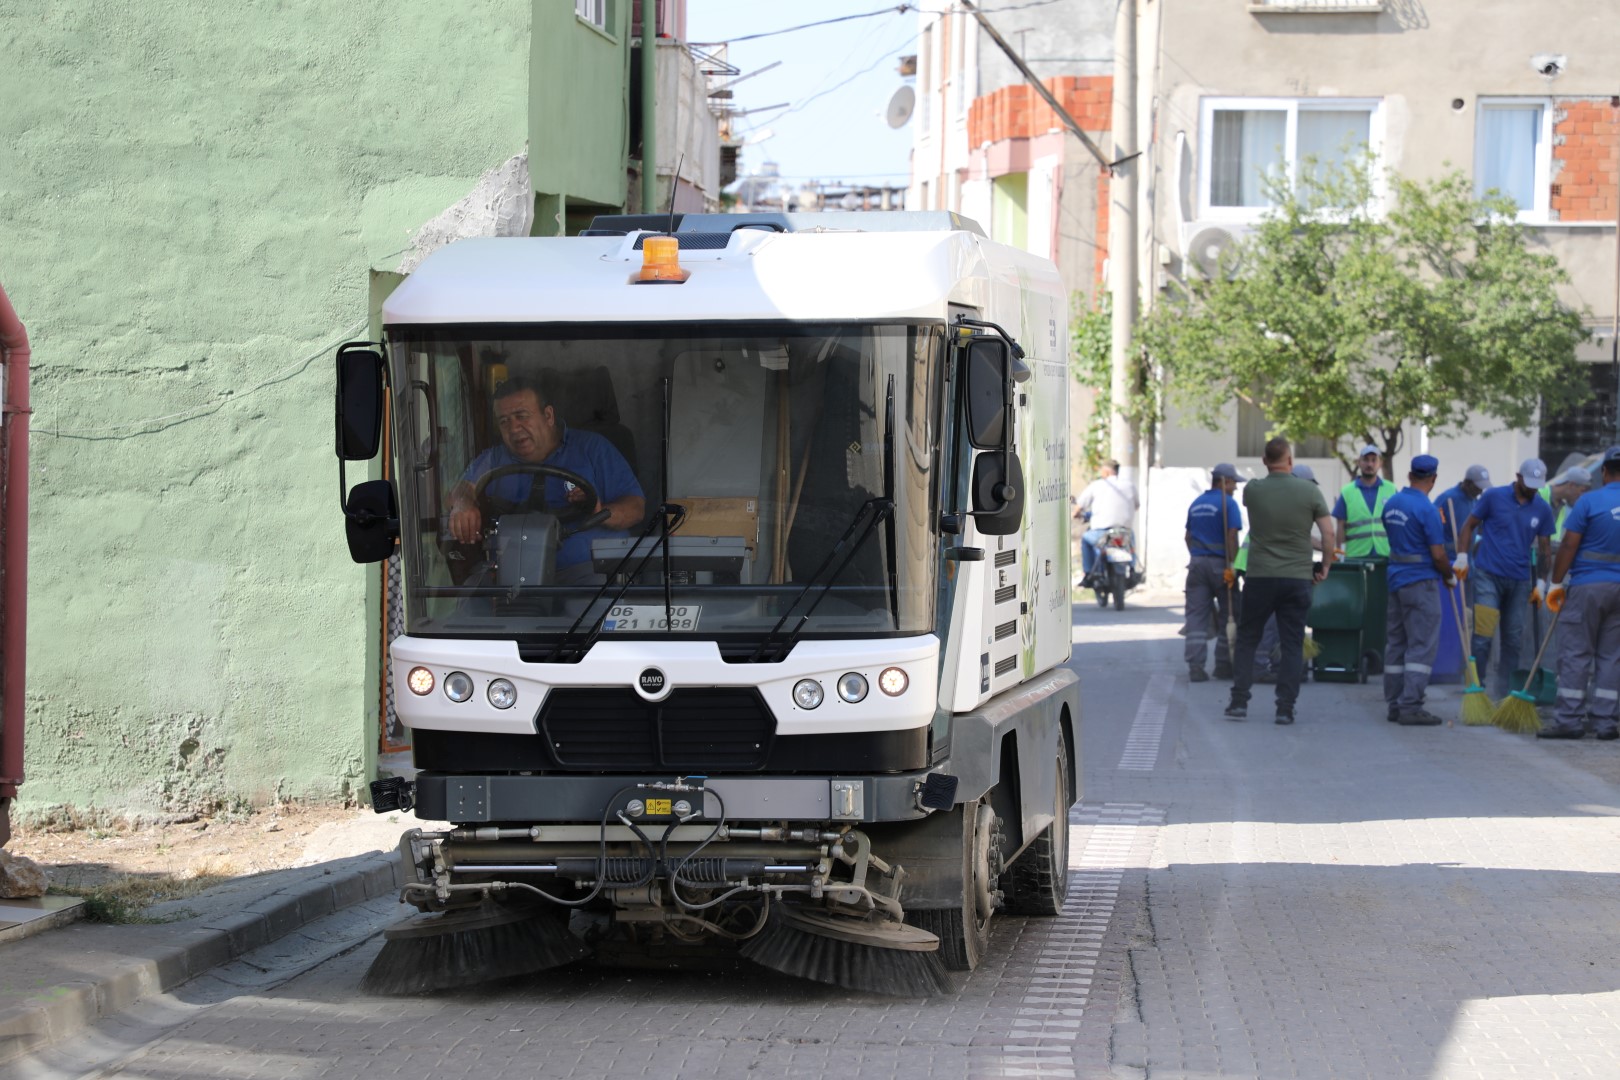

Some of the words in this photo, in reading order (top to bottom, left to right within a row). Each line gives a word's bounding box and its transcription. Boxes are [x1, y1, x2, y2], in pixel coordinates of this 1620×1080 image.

[610, 607, 633, 617] 06
[617, 619, 638, 629] 21
[649, 619, 692, 629] 1098
[641, 676, 663, 684] RAVO
